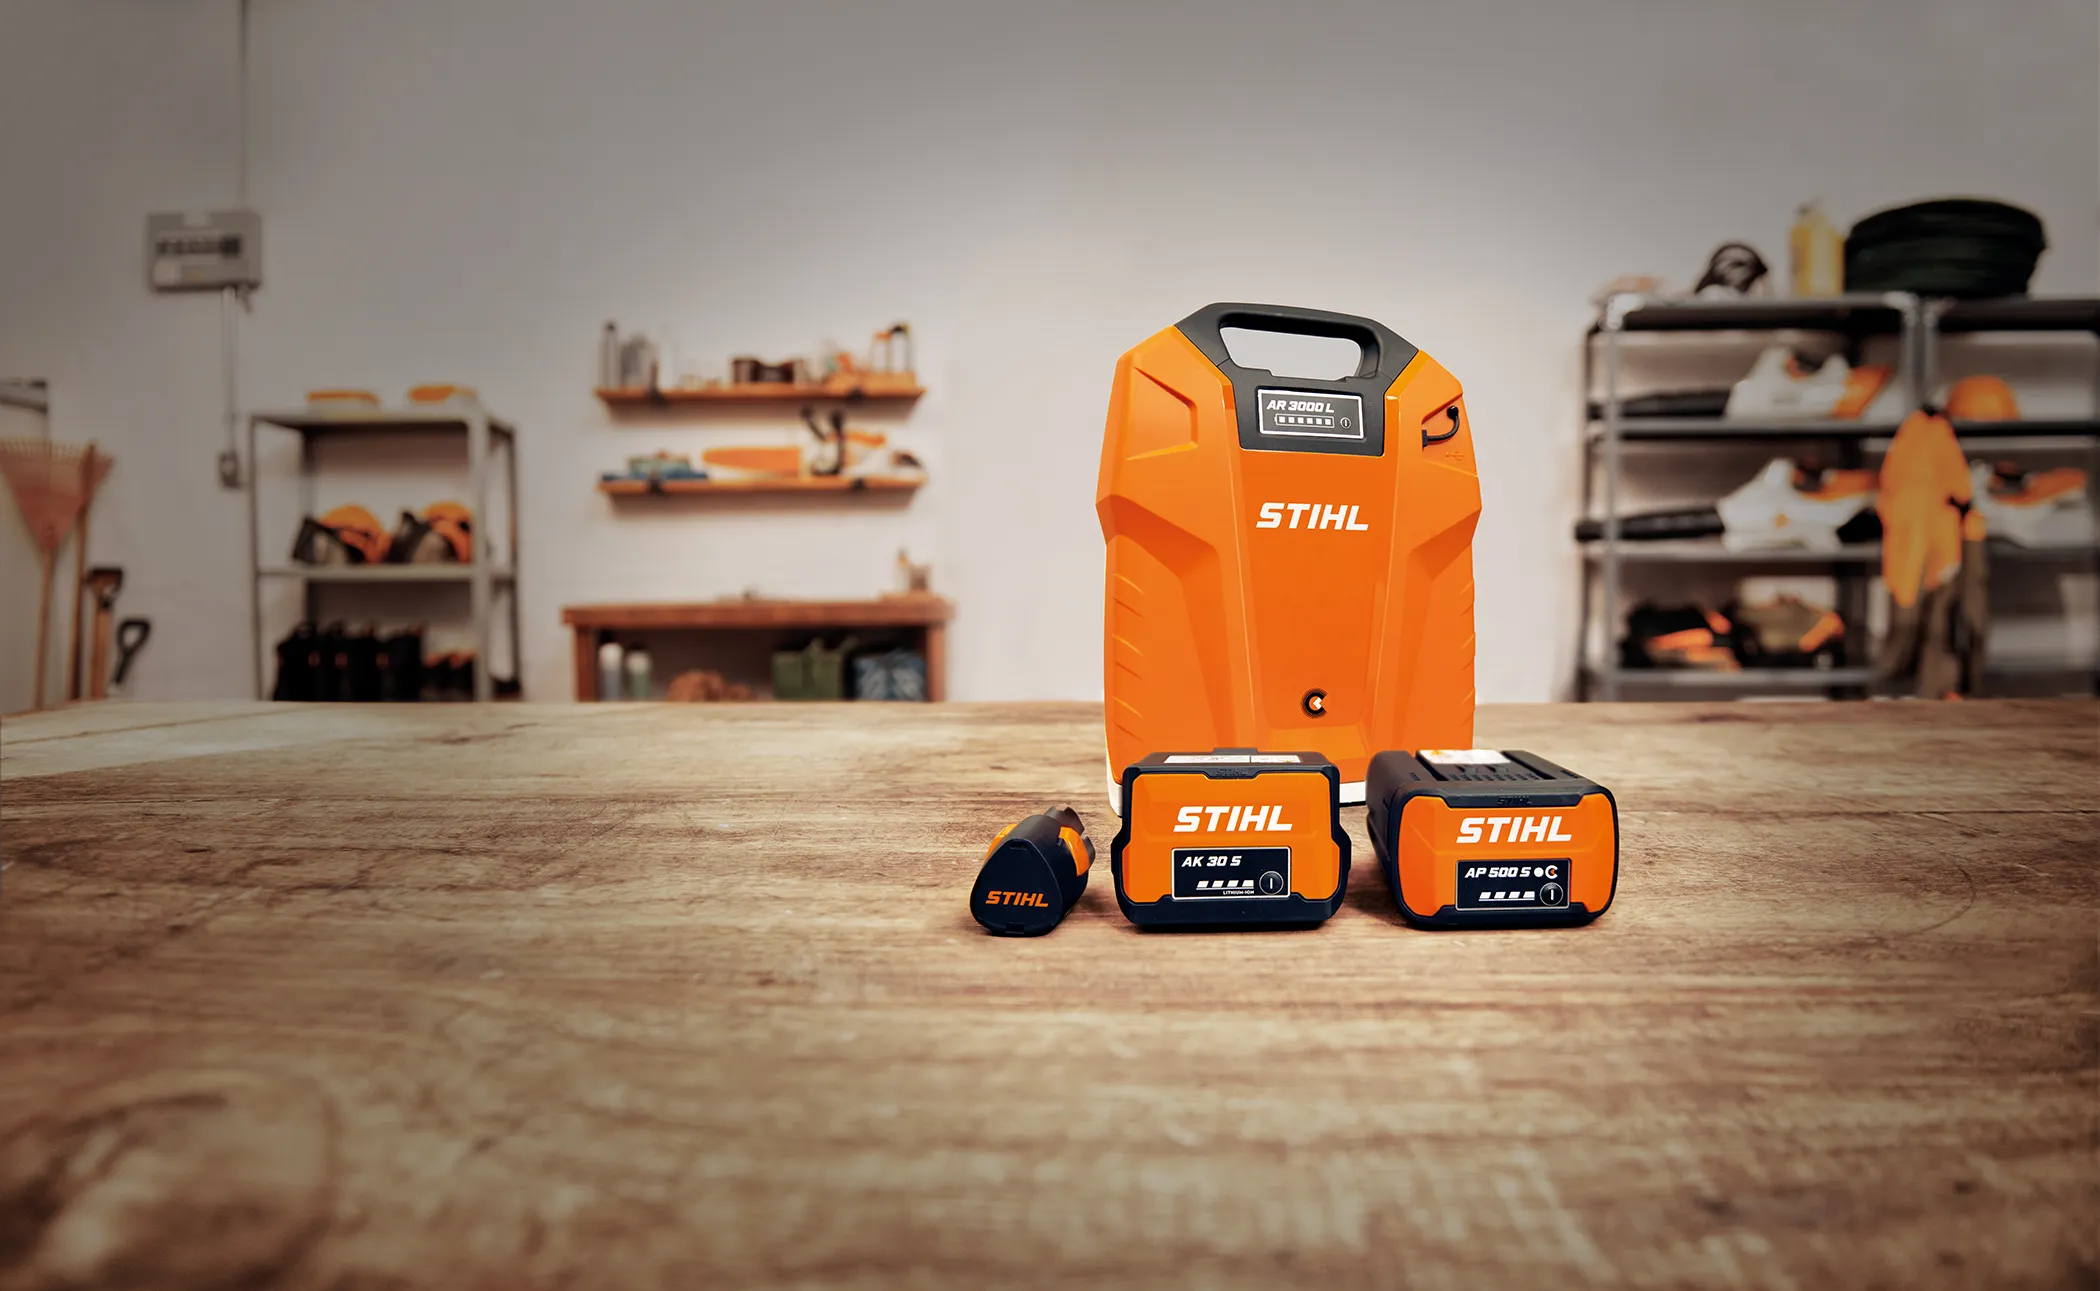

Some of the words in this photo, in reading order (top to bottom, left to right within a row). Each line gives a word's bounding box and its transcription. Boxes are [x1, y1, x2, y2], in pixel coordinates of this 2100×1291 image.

[1266, 400, 1287, 411] AR
[1288, 400, 1324, 413] 3000
[1325, 403, 1335, 413] L
[1256, 502, 1369, 531] STIHL
[1173, 805, 1293, 832] STIHL
[1456, 816, 1572, 843] STIHL
[1181, 856, 1204, 867] AK
[1206, 856, 1228, 867] 30
[1230, 855, 1242, 867] S
[1464, 867, 1487, 878] AP
[1488, 867, 1519, 878] 500
[1519, 866, 1532, 878] S
[985, 890, 1049, 907] STIHL
